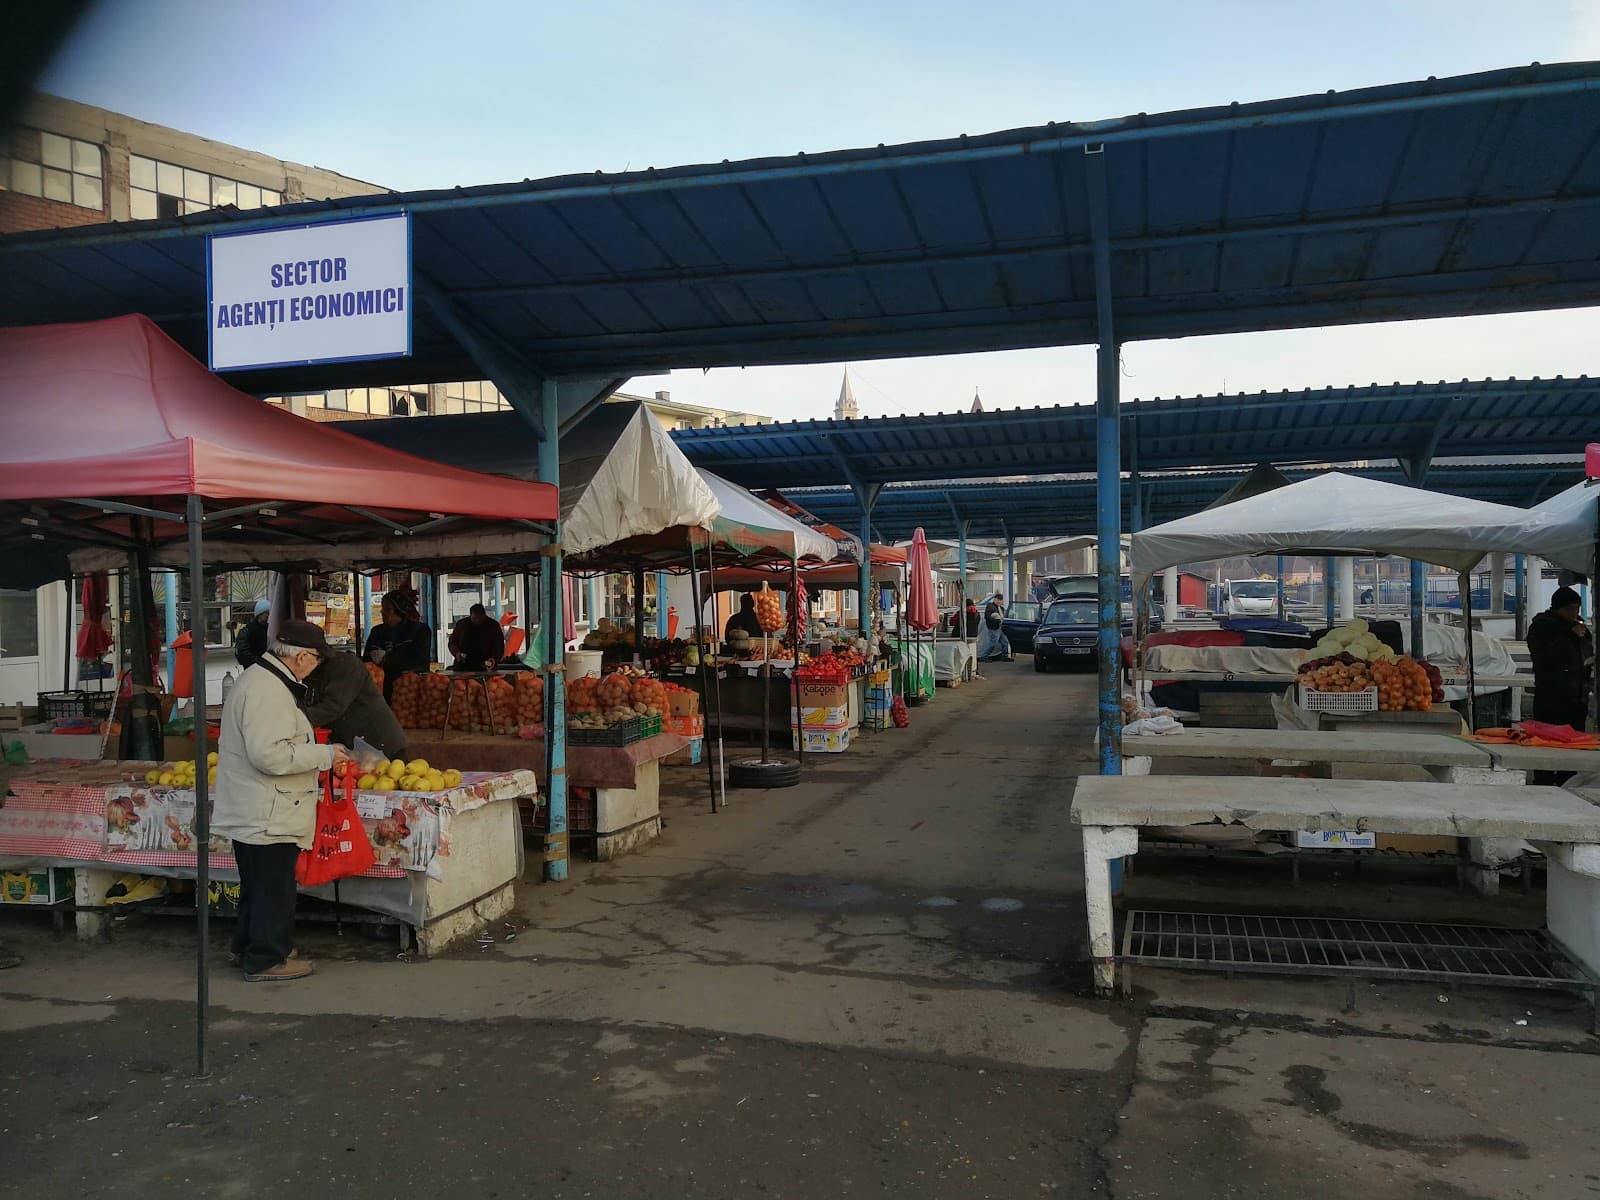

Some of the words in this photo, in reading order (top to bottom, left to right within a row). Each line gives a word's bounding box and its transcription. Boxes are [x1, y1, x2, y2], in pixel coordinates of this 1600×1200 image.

[271, 257, 347, 288] SECTOR
[217, 299, 285, 331] AGENȚI
[290, 287, 404, 322] ECONOMICI
[803, 685, 836, 696] Katope
